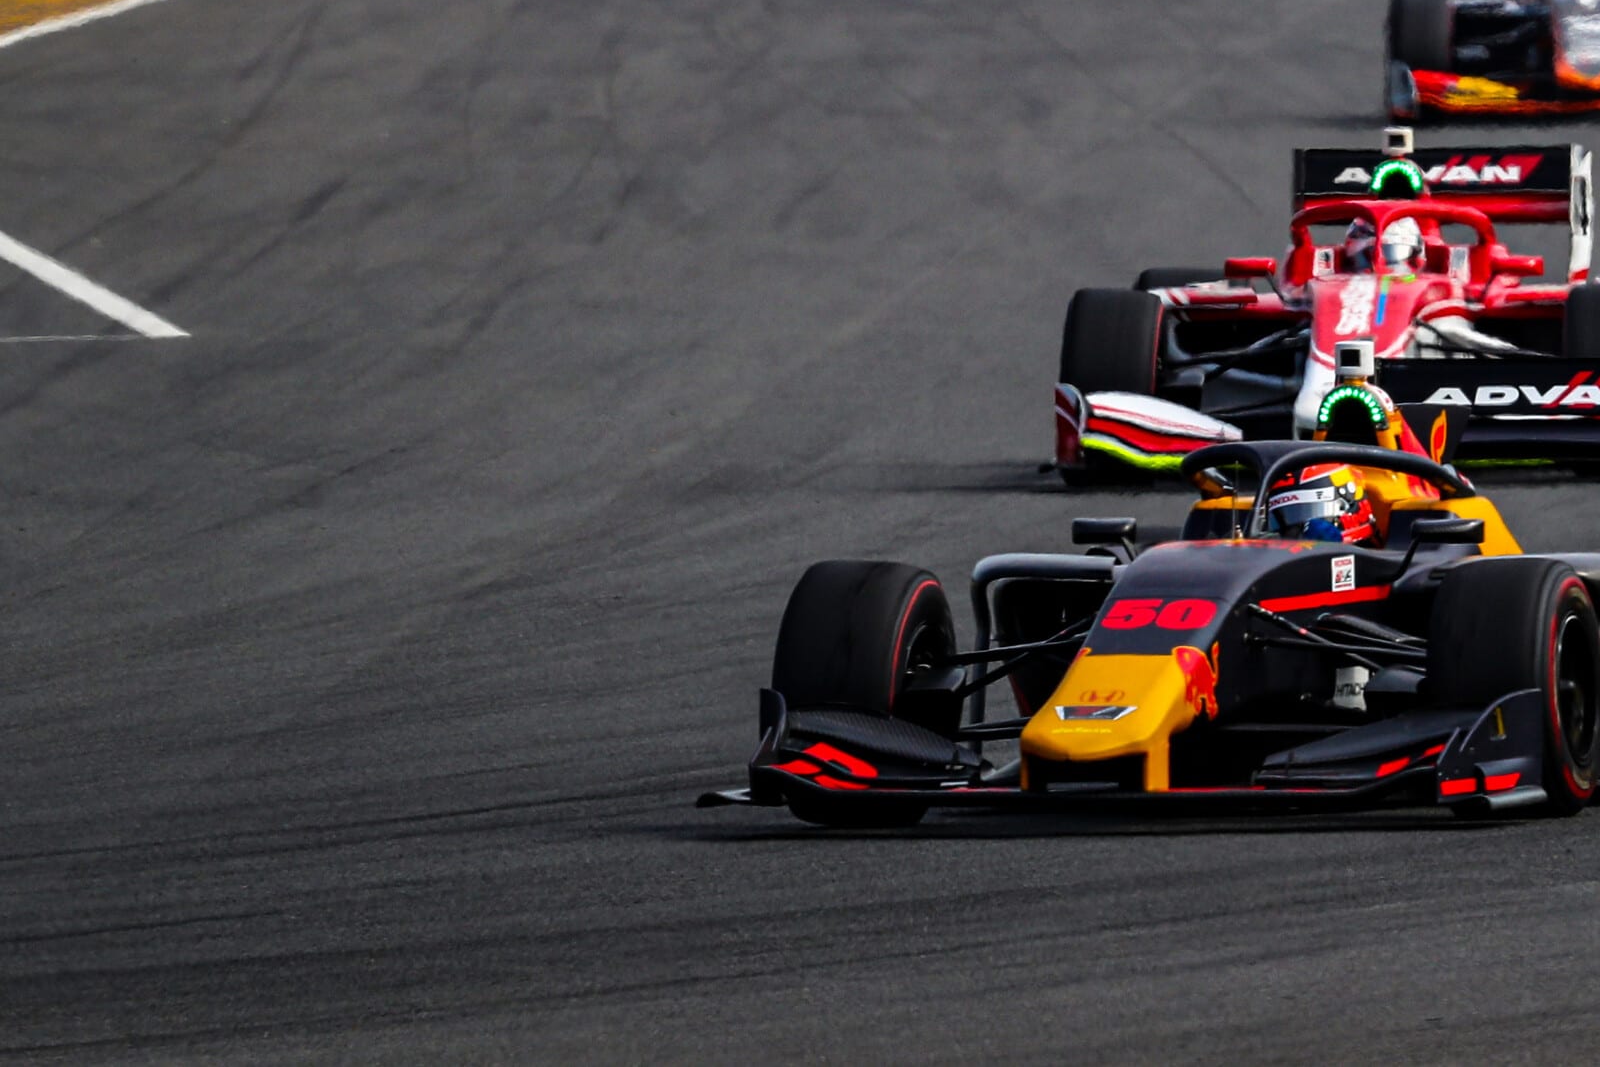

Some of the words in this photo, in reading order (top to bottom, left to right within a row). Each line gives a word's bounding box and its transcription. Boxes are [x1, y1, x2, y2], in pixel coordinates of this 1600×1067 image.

[1334, 164, 1522, 184] AVAN
[1269, 494, 1299, 507] ONDA
[1101, 598, 1218, 631] 50
